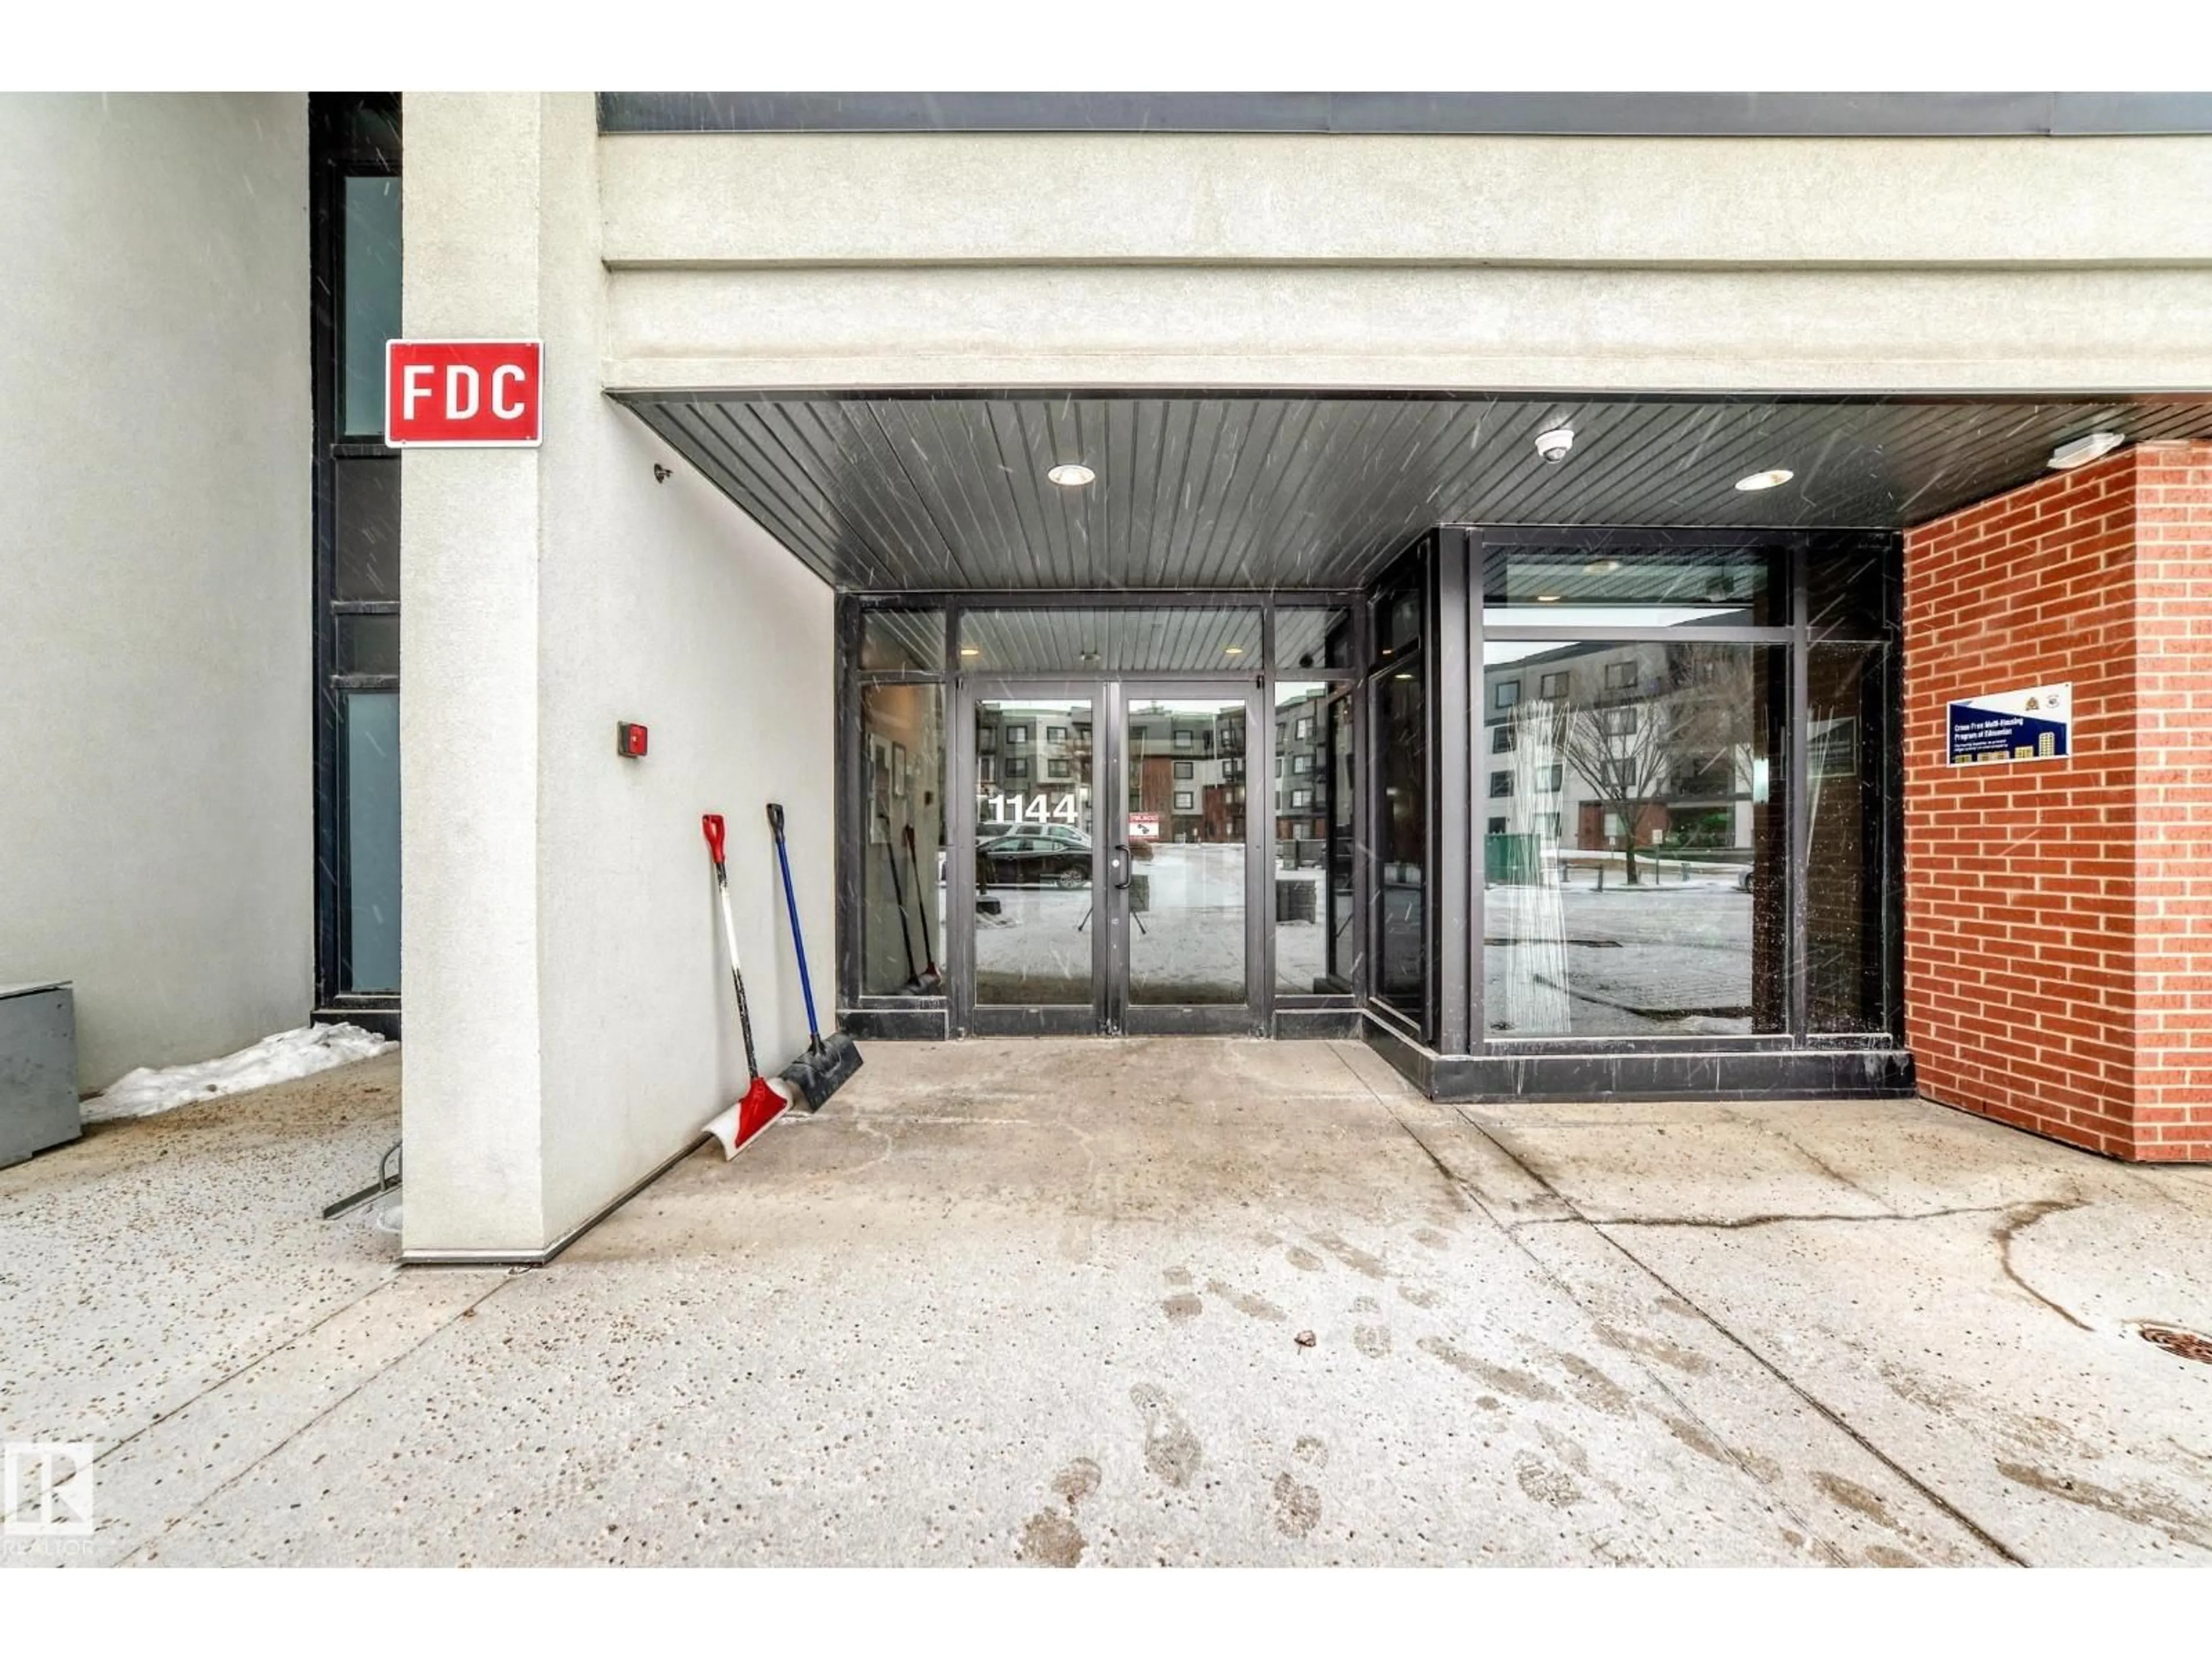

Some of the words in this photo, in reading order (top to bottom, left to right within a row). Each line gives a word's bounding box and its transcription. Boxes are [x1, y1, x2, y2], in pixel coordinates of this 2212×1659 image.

[403, 363, 526, 421] FDC
[1971, 722, 1983, 730] Free
[1955, 733, 1976, 741] Program
[988, 793, 1078, 824] 1144
